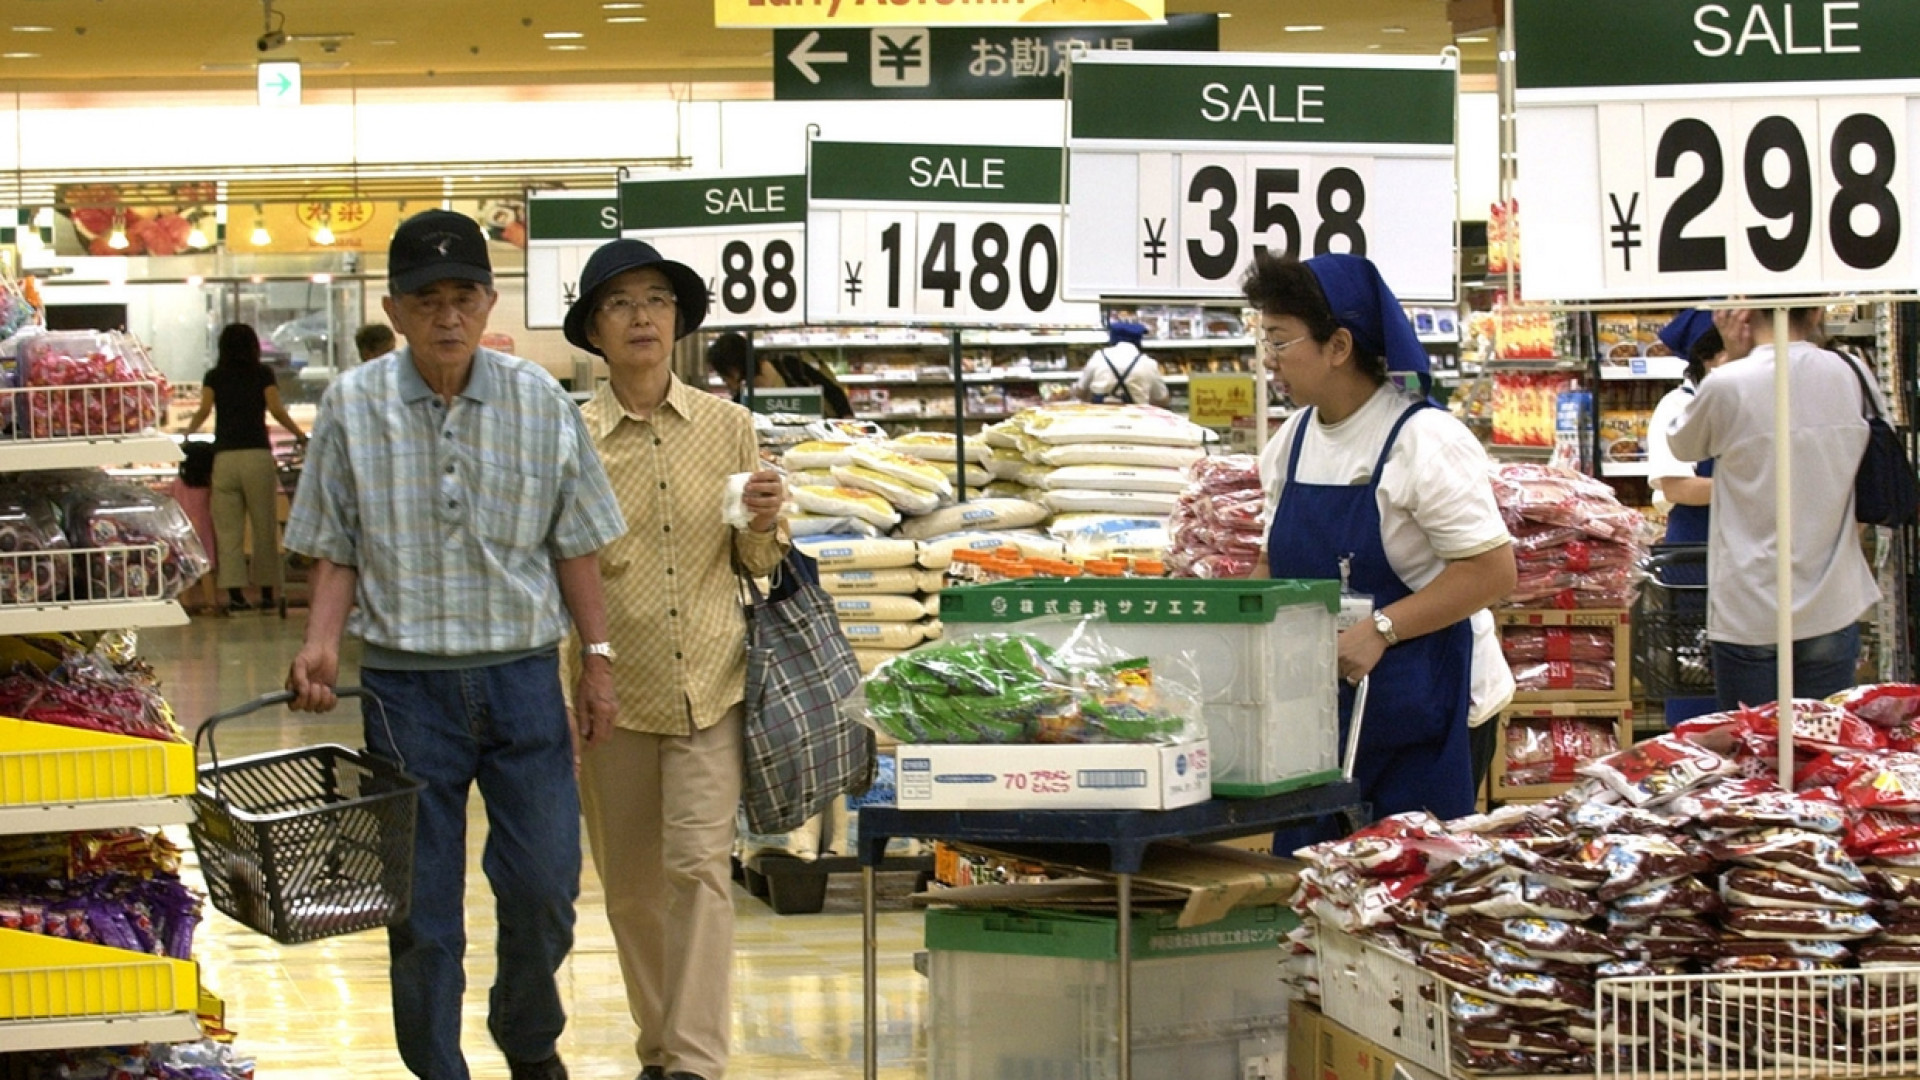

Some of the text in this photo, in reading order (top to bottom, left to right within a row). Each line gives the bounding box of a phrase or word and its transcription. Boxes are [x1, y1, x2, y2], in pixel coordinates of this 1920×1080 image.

[1693, 2, 1861, 58] SALE
[1200, 83, 1325, 123] SALE
[909, 157, 1005, 189] SALE
[1609, 113, 1901, 272] ¥ 298
[705, 186, 785, 214] SALE
[1144, 165, 1367, 280] ¥ 358
[722, 240, 797, 314] 88
[845, 222, 1058, 312] ¥ 1480
[766, 398, 801, 411] SALE
[1020, 599, 1207, 615] 株式会社サンエス
[1003, 773, 1027, 789] 70
